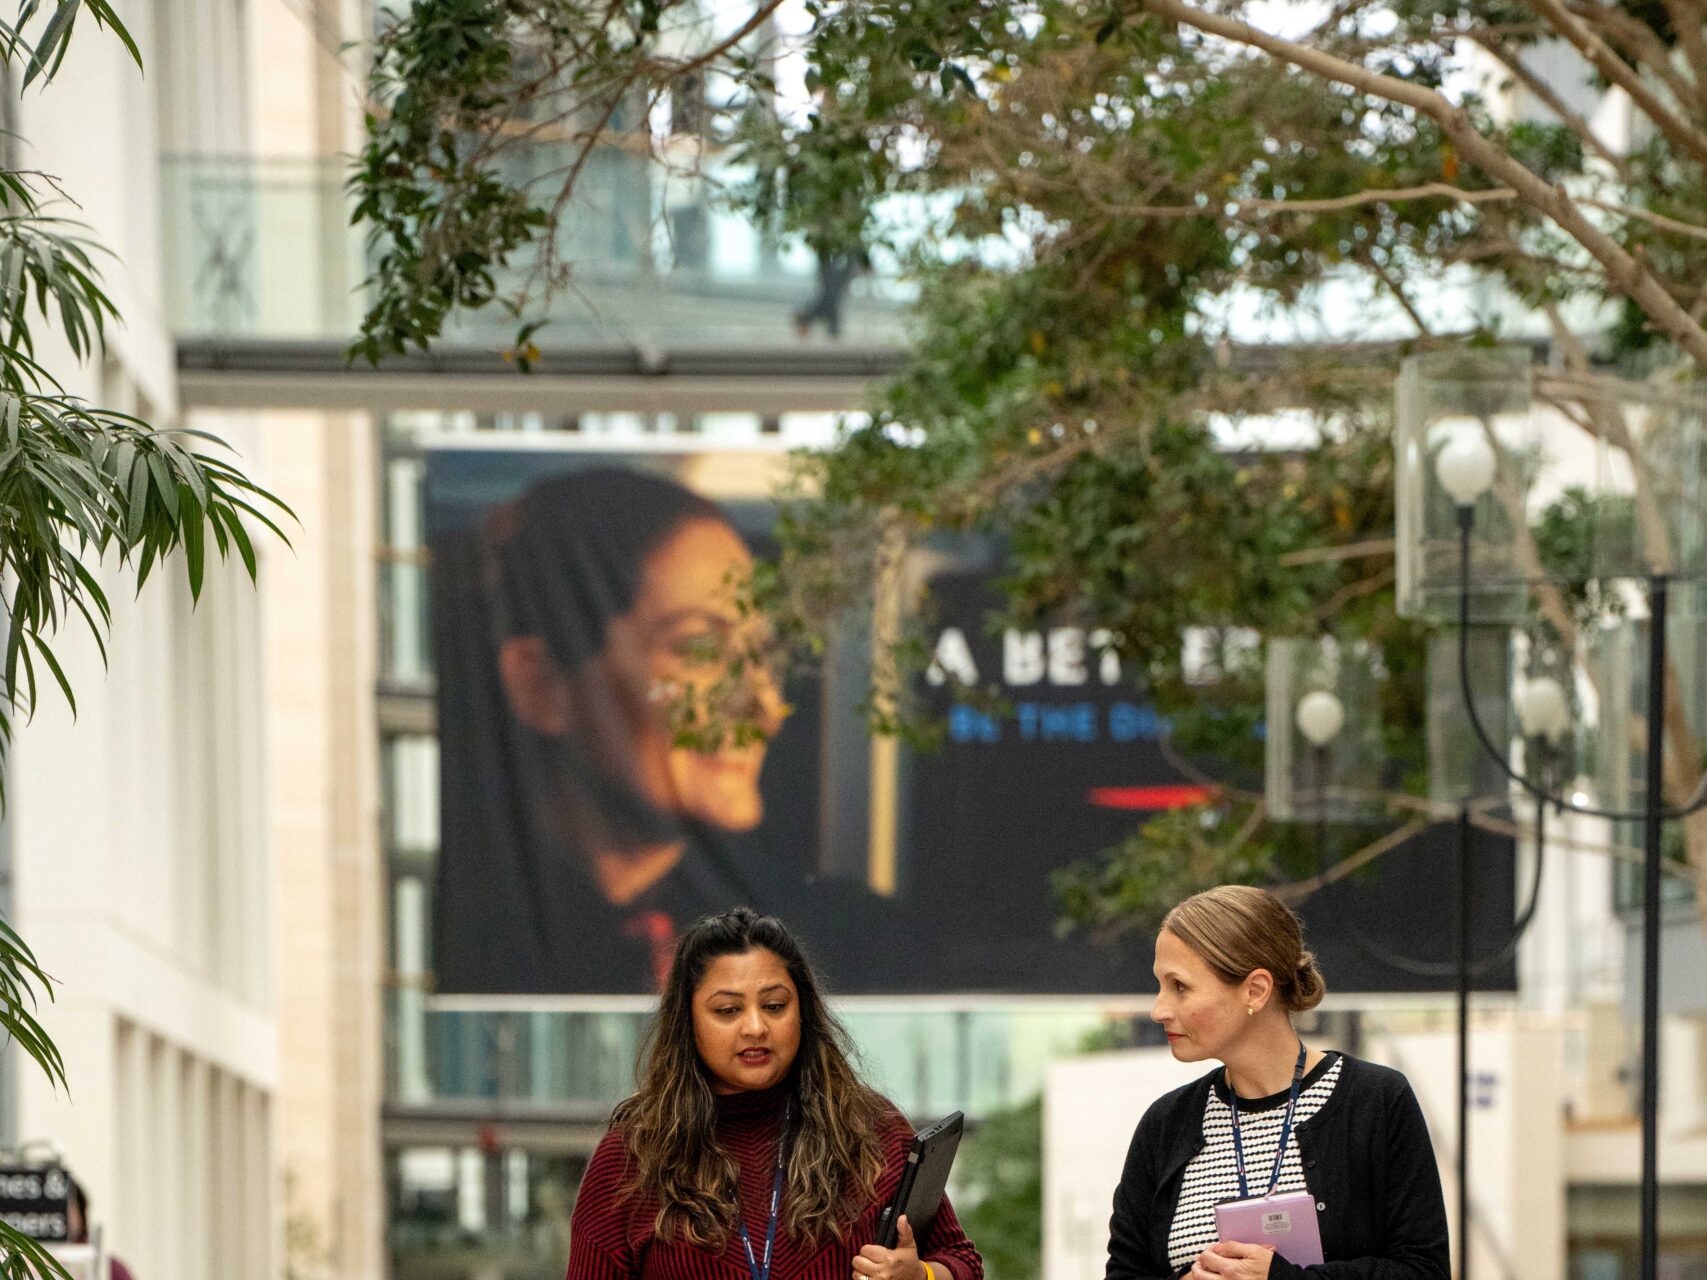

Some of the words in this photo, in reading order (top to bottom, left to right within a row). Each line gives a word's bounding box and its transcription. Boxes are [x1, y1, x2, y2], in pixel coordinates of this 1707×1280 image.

[926, 627, 980, 687] A
[1018, 702, 1096, 743] THE
[43, 1167, 68, 1200] &
